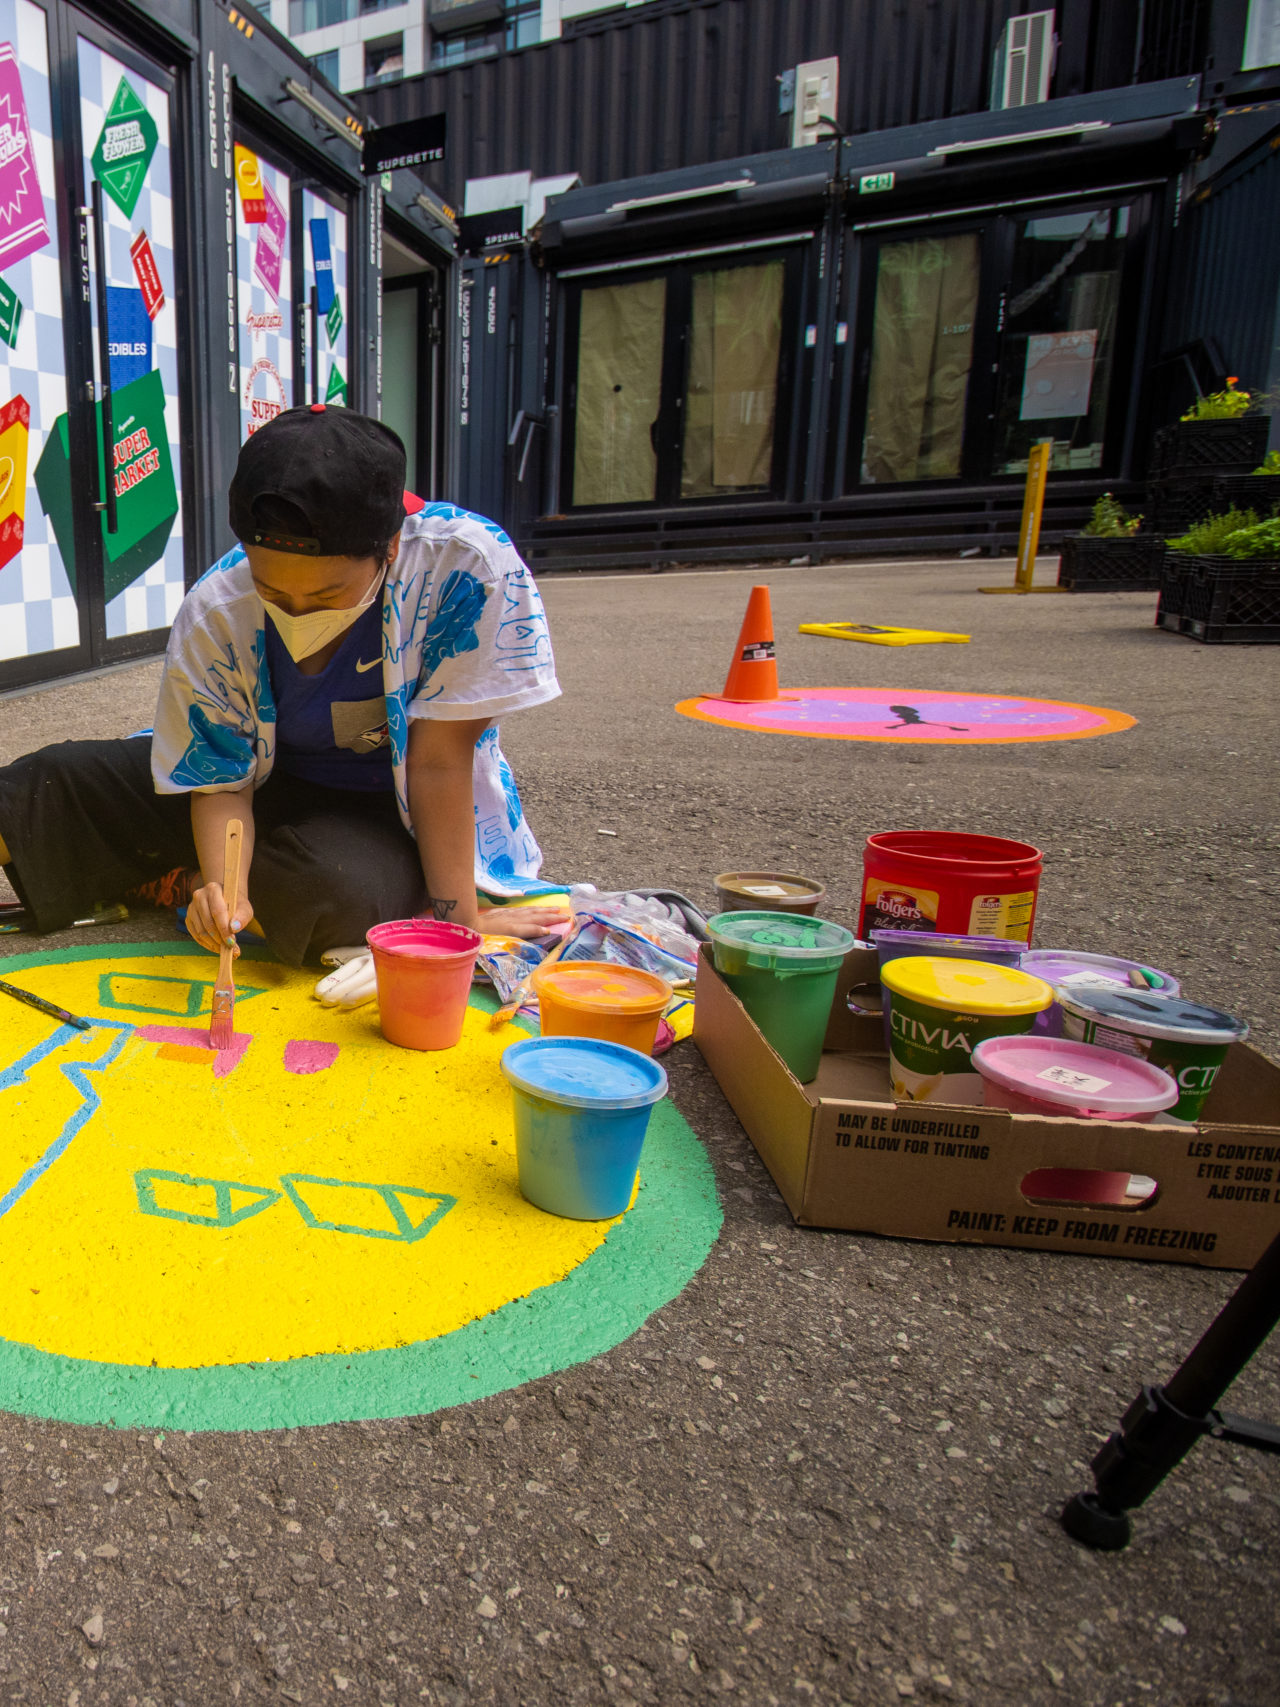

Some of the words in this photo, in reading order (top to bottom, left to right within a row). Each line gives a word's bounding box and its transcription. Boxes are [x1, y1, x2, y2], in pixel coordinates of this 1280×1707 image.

[105, 121, 141, 143] FRESH
[103, 134, 146, 161] FLOWER
[377, 147, 444, 172] SUPERETTE
[485, 231, 521, 246] SPIRAL
[251, 399, 282, 420] SUPER
[875, 894, 922, 919] Folgers
[837, 1113, 868, 1130] MAY
[870, 1116, 888, 1131] BE
[891, 1118, 980, 1140] UNDERFILLED
[835, 1132, 851, 1147] TO
[854, 1135, 901, 1152] ALLOW
[904, 1138, 929, 1154] FOR
[933, 1142, 990, 1161] TINTING
[1187, 1142, 1213, 1158] LES
[1197, 1163, 1231, 1180] ETRE
[1234, 1166, 1273, 1183] SOUS
[1206, 1184, 1269, 1203] AJOUTER
[947, 1210, 1007, 1232] PAINT:
[1012, 1216, 1059, 1236] KEEP
[1063, 1221, 1120, 1242] FROM
[1124, 1226, 1217, 1252] FREEZING
